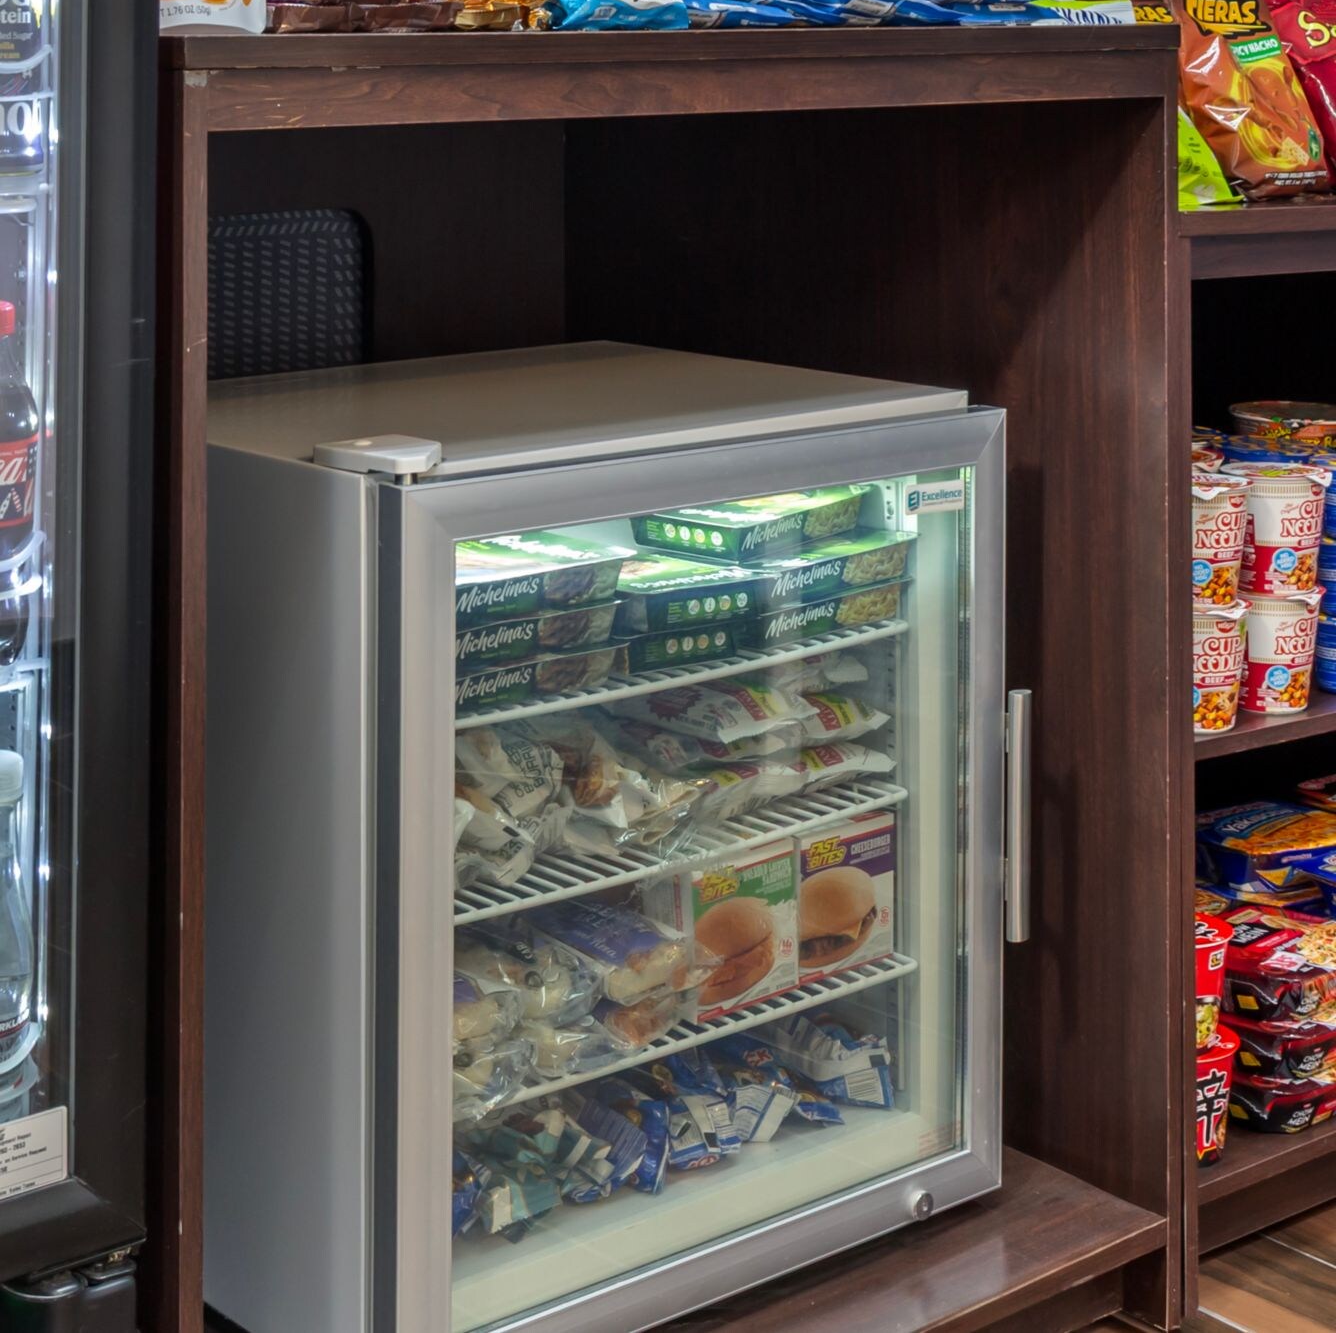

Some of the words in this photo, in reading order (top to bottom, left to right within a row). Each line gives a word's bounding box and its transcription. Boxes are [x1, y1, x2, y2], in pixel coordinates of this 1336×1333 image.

[167, 6, 184, 17] 1.76
[184, 4, 195, 14] OZ
[1134, 5, 1174, 24] RAS
[1249, 38, 1279, 54] NACHO
[921, 488, 963, 503] Excellence
[1299, 499, 1325, 519] CU
[741, 513, 804, 552] Michelina's
[1195, 527, 1246, 549] NOOD
[1280, 518, 1324, 538] NOOD
[771, 560, 842, 598] Michelina's
[456, 575, 540, 614] Michelina's
[765, 601, 836, 640] Michelina's
[1293, 618, 1319, 637] CU
[456, 622, 534, 661] Michelina's
[1202, 636, 1242, 656] CUP
[1193, 653, 1242, 674] OODLE
[456, 667, 533, 705] Michelina's
[1204, 675, 1225, 684] BEEF
[809, 836, 841, 857] FAST
[810, 848, 846, 868] BITES
[1303, 1051, 1325, 1064] CHOW
[1287, 1115, 1311, 1126] MEIN
[1292, 1106, 1315, 1118] CHOW
